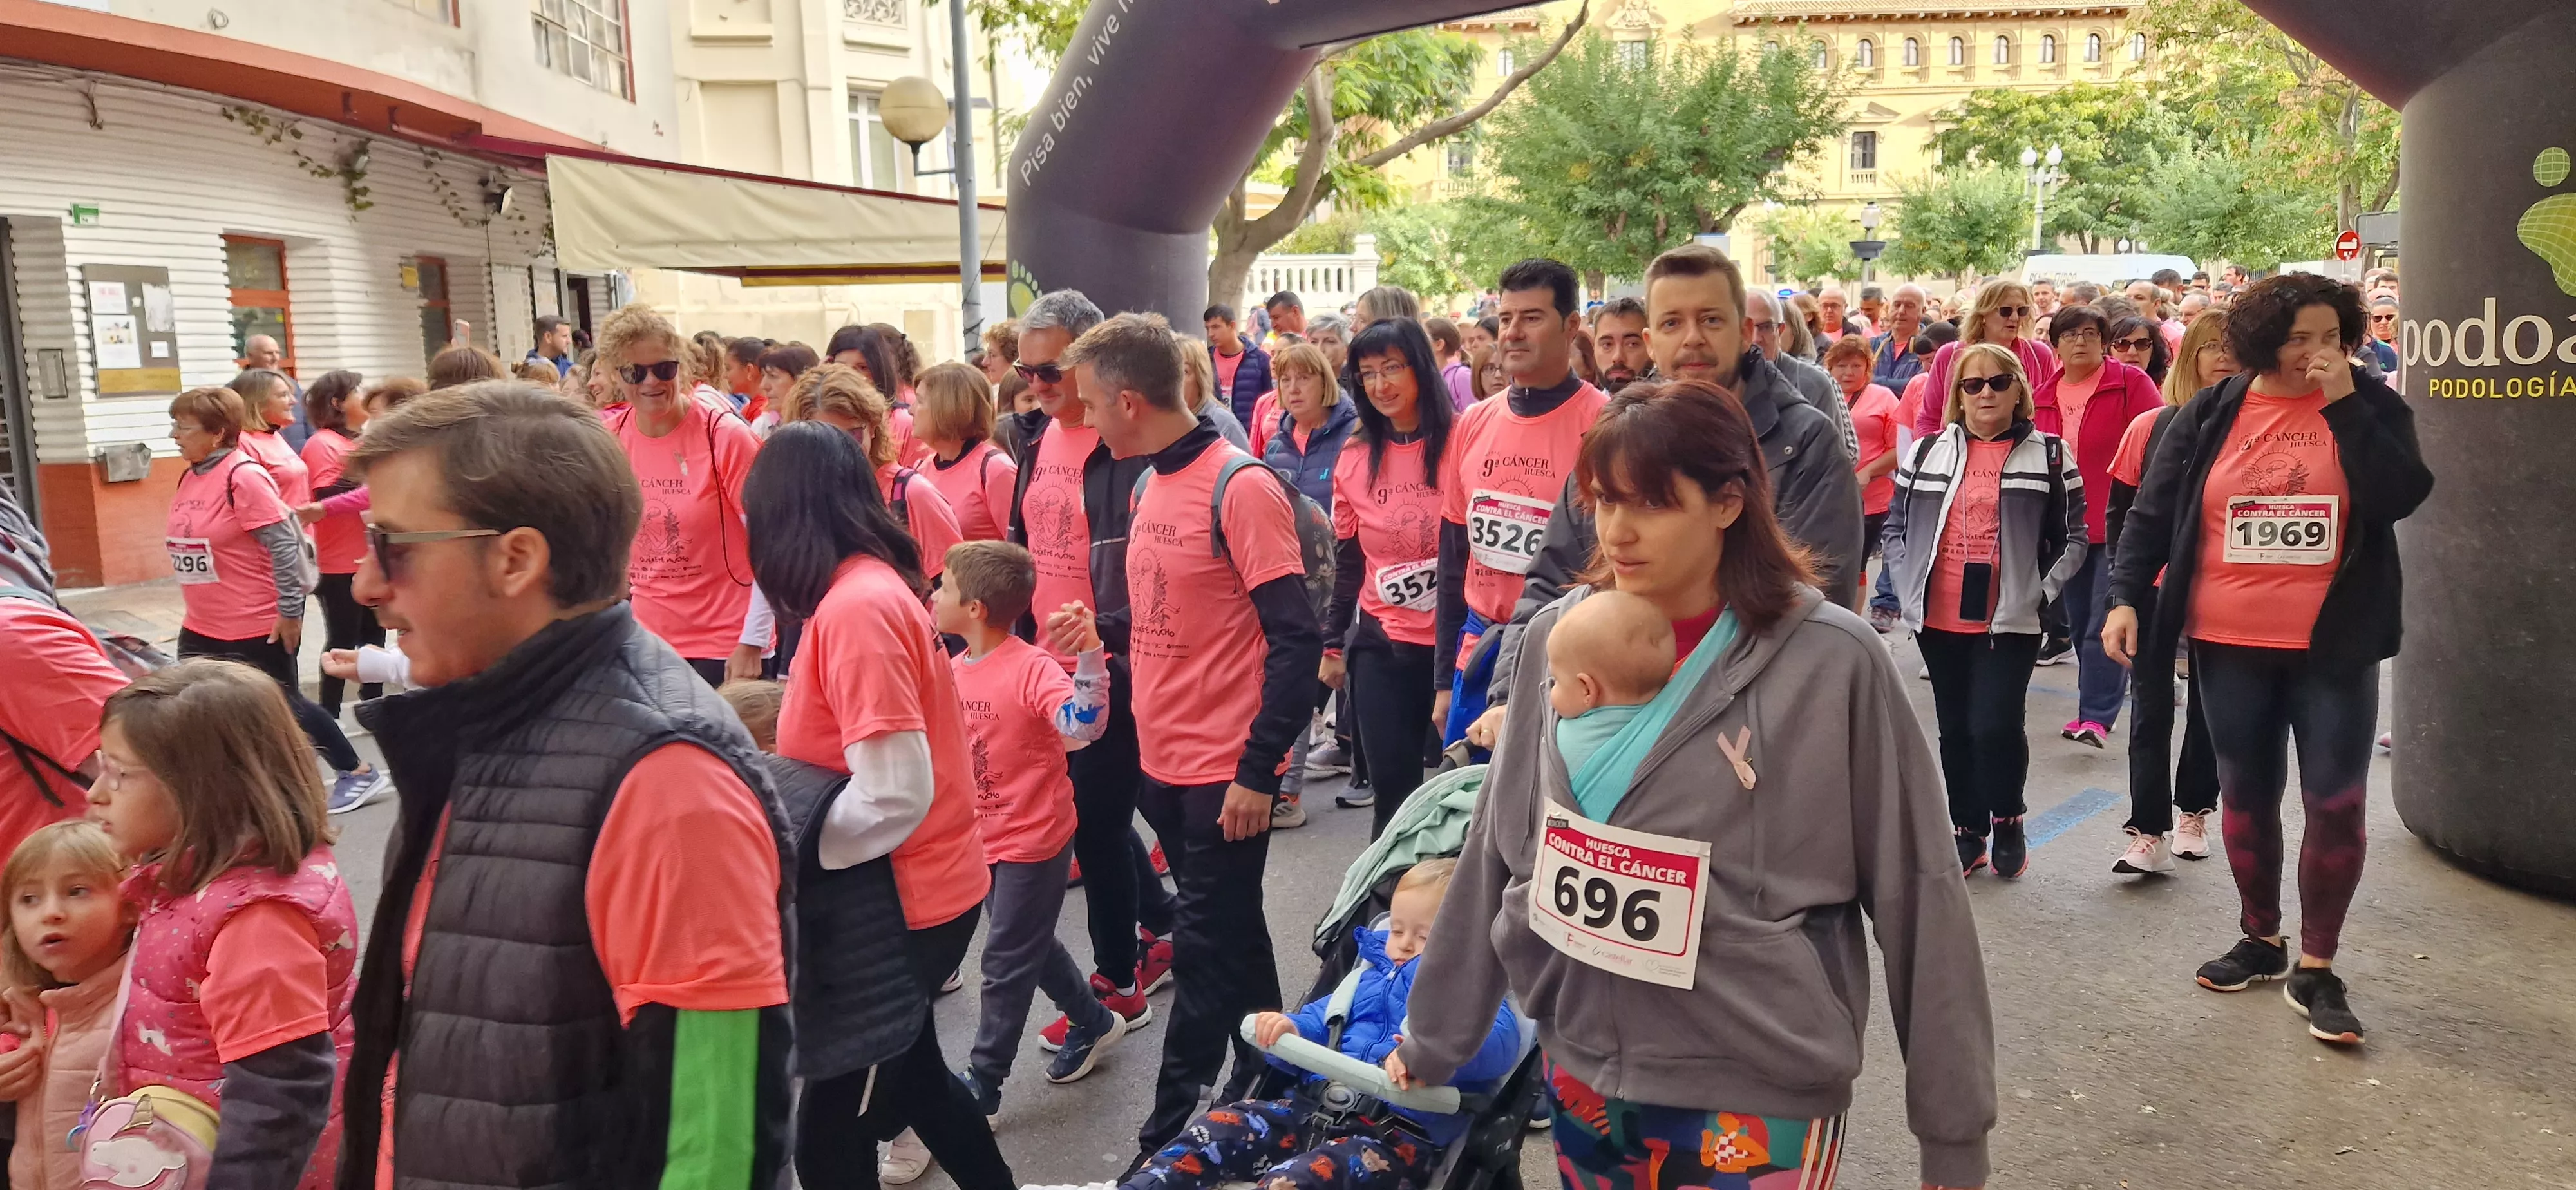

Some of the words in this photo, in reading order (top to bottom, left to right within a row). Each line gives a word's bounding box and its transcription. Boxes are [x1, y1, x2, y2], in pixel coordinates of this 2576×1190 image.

[1020, 133, 1055, 186] Pisa
[1050, 75, 1093, 132] bien,
[1087, 14, 1120, 65] vive
[2429, 370, 2576, 398] PODOLOGÍA
[1482, 459, 1499, 477] 9ª
[1502, 455, 1549, 469] CÁNCER
[1525, 468, 1556, 478] HUESCA
[1973, 469, 2000, 477] CÁNC
[641, 477, 683, 488] CÁNCER
[1417, 490, 1444, 498] HUESCA
[1476, 504, 1502, 516] CONTRA
[1503, 509, 1513, 518] EL
[1498, 502, 1522, 511] HUESCA
[2289, 509, 2326, 517] CÁNCER
[1142, 520, 1177, 536] CÁNCER
[2235, 520, 2326, 547] 1969
[1154, 535, 1183, 547] HUESCA
[1472, 517, 1545, 556] 3526
[1383, 567, 1411, 581] CONTRA
[1385, 570, 1437, 605] 352
[1151, 628, 1175, 637] MUCHO
[971, 712, 999, 721] HUESCA
[1586, 838, 1631, 858] HUESCA
[1548, 833, 1595, 865] CONTRA
[1598, 855, 1615, 870] EL
[1619, 860, 1687, 884] CÁNCER
[1554, 865, 1661, 941] 696
